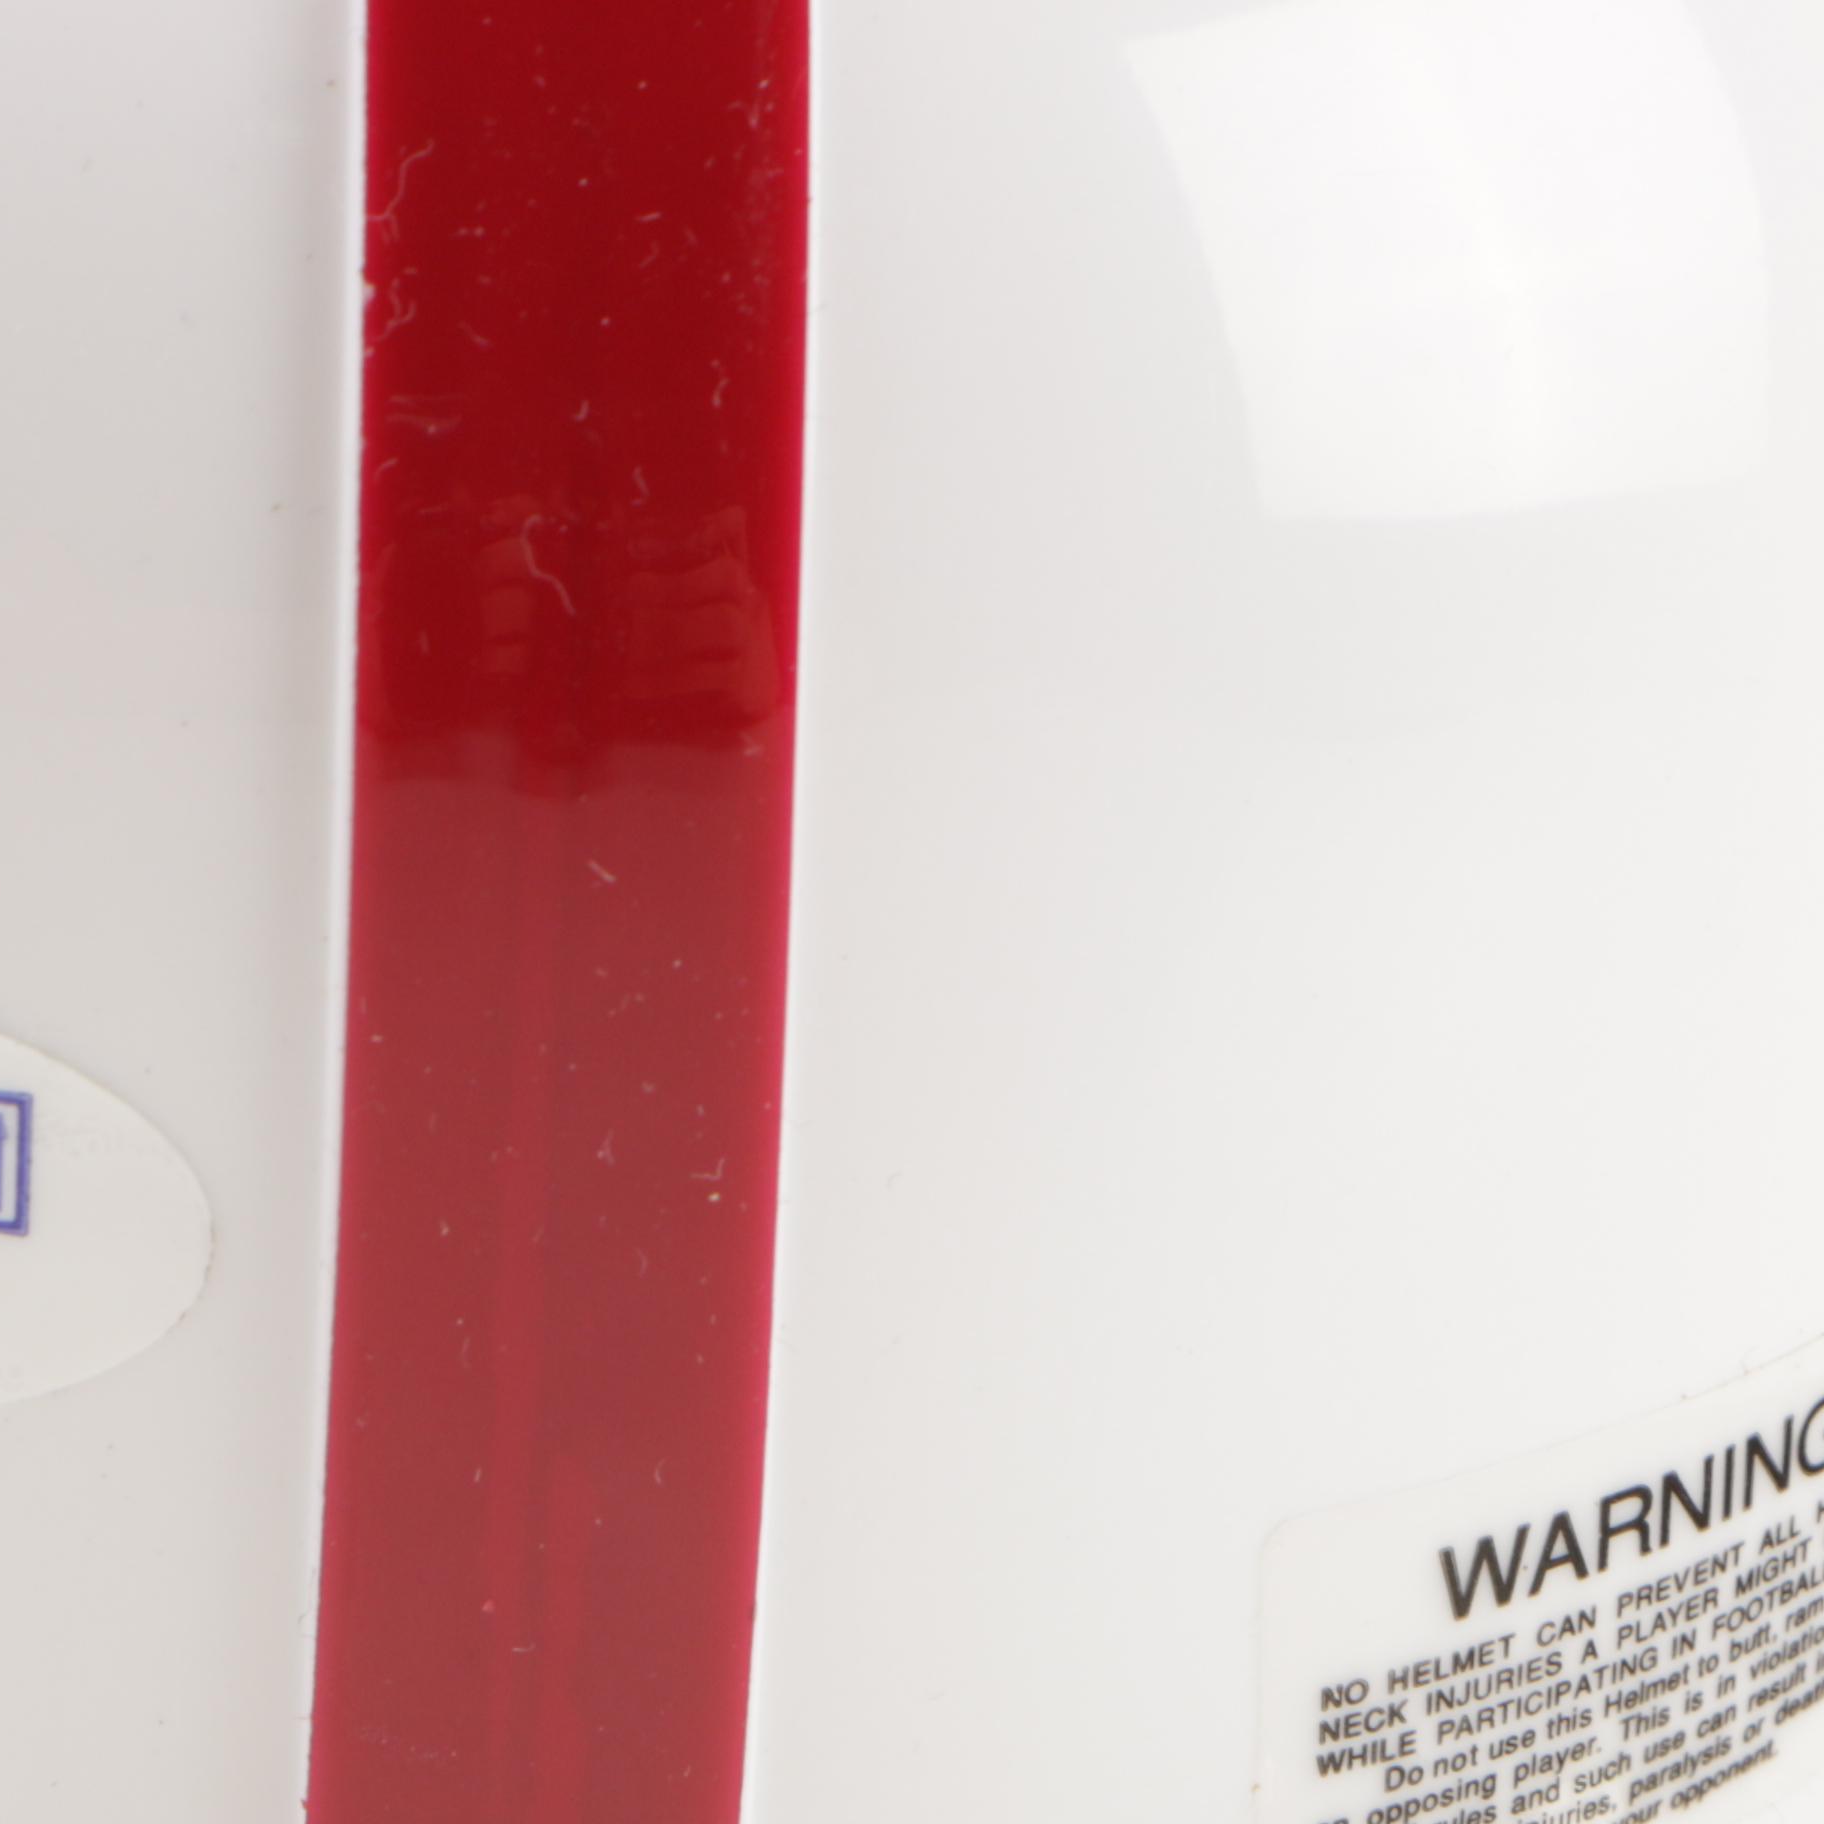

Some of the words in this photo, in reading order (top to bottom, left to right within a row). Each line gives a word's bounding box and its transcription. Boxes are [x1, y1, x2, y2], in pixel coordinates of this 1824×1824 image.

[1319, 1699, 1408, 1745] NECK
[1426, 1651, 1563, 1715] INJURIES
[1581, 1639, 1598, 1664] A
[1617, 1587, 1719, 1649] PLAYER
[1735, 1537, 1812, 1597] MIGHT
[1321, 1679, 1369, 1712] NO
[1387, 1633, 1516, 1694] HELMET
[1536, 1605, 1596, 1646] CAN
[1617, 1541, 1744, 1618] PREVENT
[1760, 1514, 1800, 1555] ALL
[1316, 1730, 1417, 1777] WHILE
[1437, 1648, 1659, 1745] PARTICIPATING
[1672, 1629, 1697, 1659] IN
[1385, 1764, 1424, 1792] Do
[1433, 1747, 1479, 1778] not
[1489, 1729, 1536, 1761] use
[1547, 1707, 1593, 1739] this
[1604, 1661, 1690, 1719] Helmet
[1698, 1652, 1719, 1677] to
[1785, 1595, 1824, 1633] ram
[1510, 1775, 1561, 1815] and
[1573, 1753, 1632, 1793] such
[1643, 1732, 1685, 1765] use
[1697, 1703, 1737, 1739] can
[1748, 1661, 1807, 1712] result
[1513, 1734, 1602, 1790] player.
[1620, 1707, 1670, 1742] This
[1684, 1689, 1703, 1713] is
[1717, 1674, 1736, 1699] in
[1628, 1735, 1732, 1807] paralysis
[1742, 1717, 1765, 1743] or
[1670, 1740, 1777, 1809] opponent.
